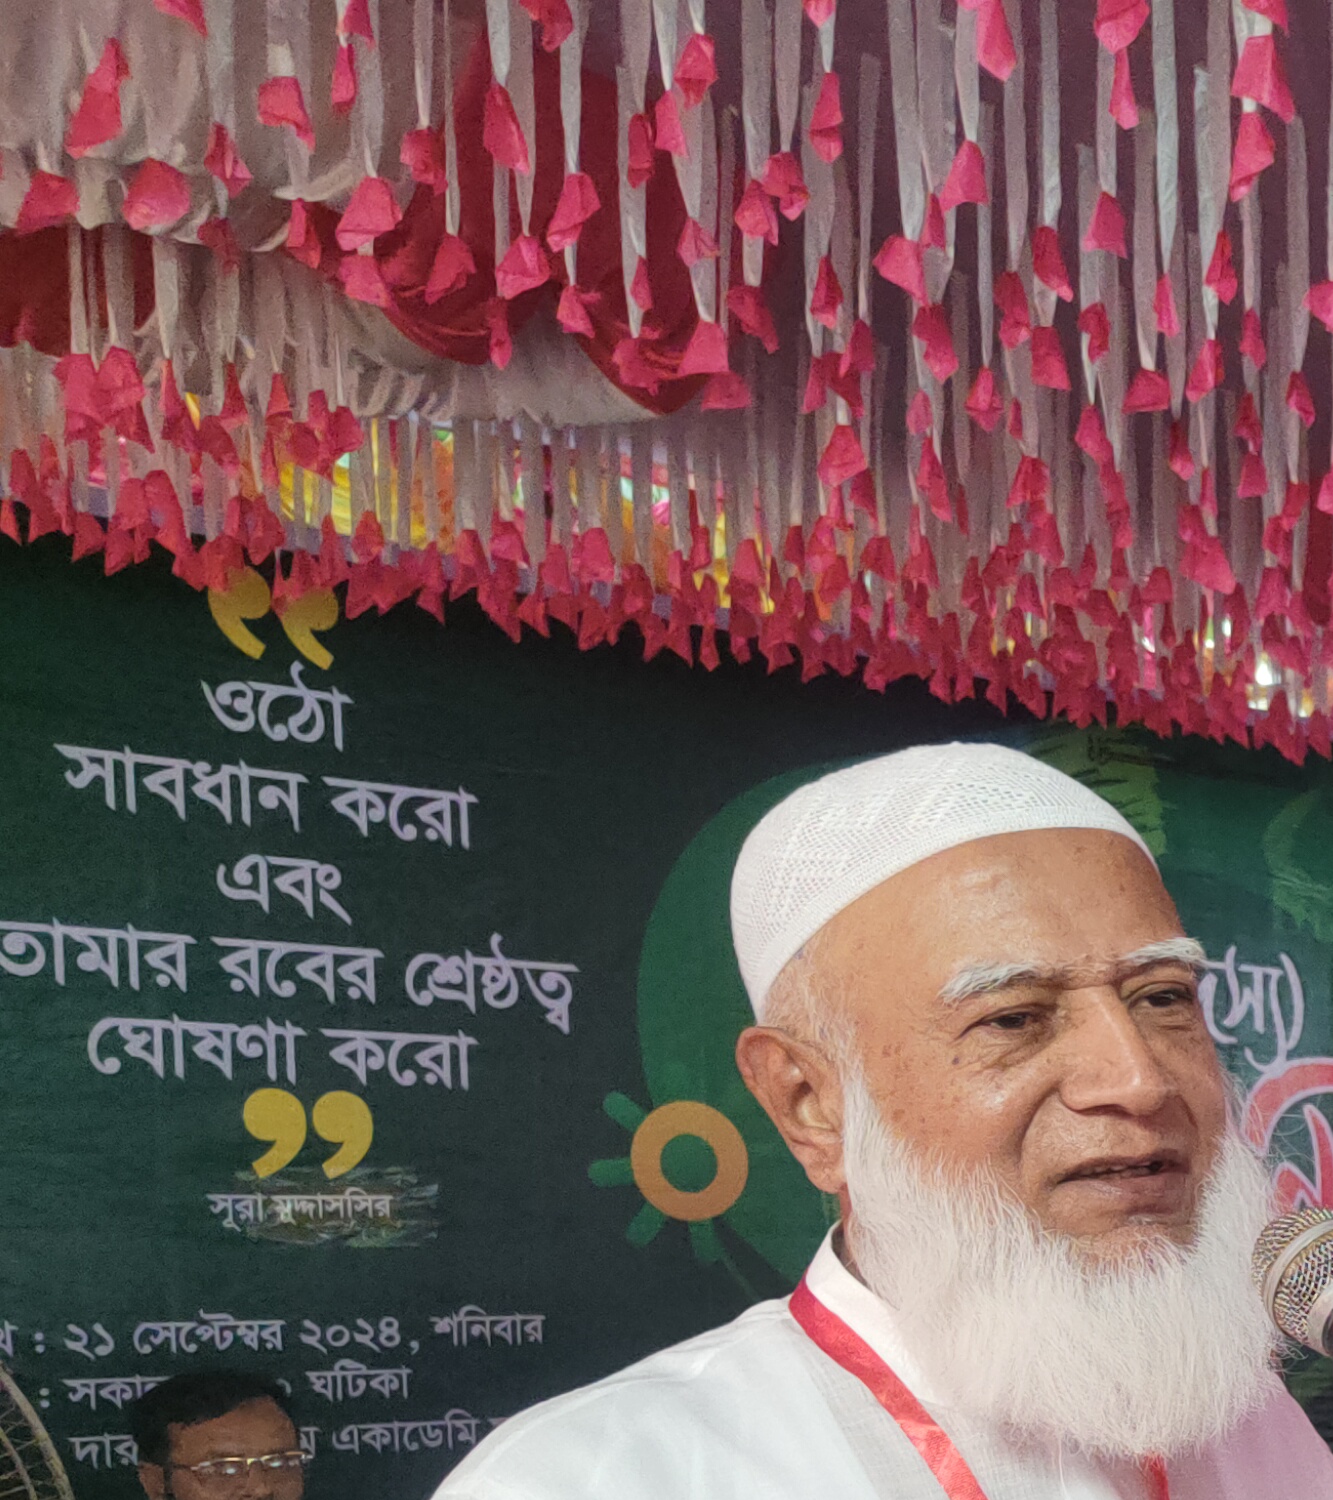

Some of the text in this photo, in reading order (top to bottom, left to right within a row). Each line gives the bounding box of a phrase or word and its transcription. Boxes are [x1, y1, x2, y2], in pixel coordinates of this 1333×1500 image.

[201, 661, 354, 751] ওঠো
[54, 744, 479, 849] সাবধান করো
[217, 854, 351, 925] এবং
[211, 936, 384, 1004] রবের
[405, 933, 579, 1034] শ্রেষ্ঠত্ব
[88, 1013, 479, 1090] ঘোষণা করো
[206, 1191, 265, 1232] সূরা
[63, 1322, 115, 1361] ২১
[133, 1308, 286, 1354] সেপ্টেম্বর
[430, 1304, 546, 1347] শনিবার
[305, 1358, 413, 1401] ঘটিকা
[332, 1408, 480, 1455] একাডেমি
